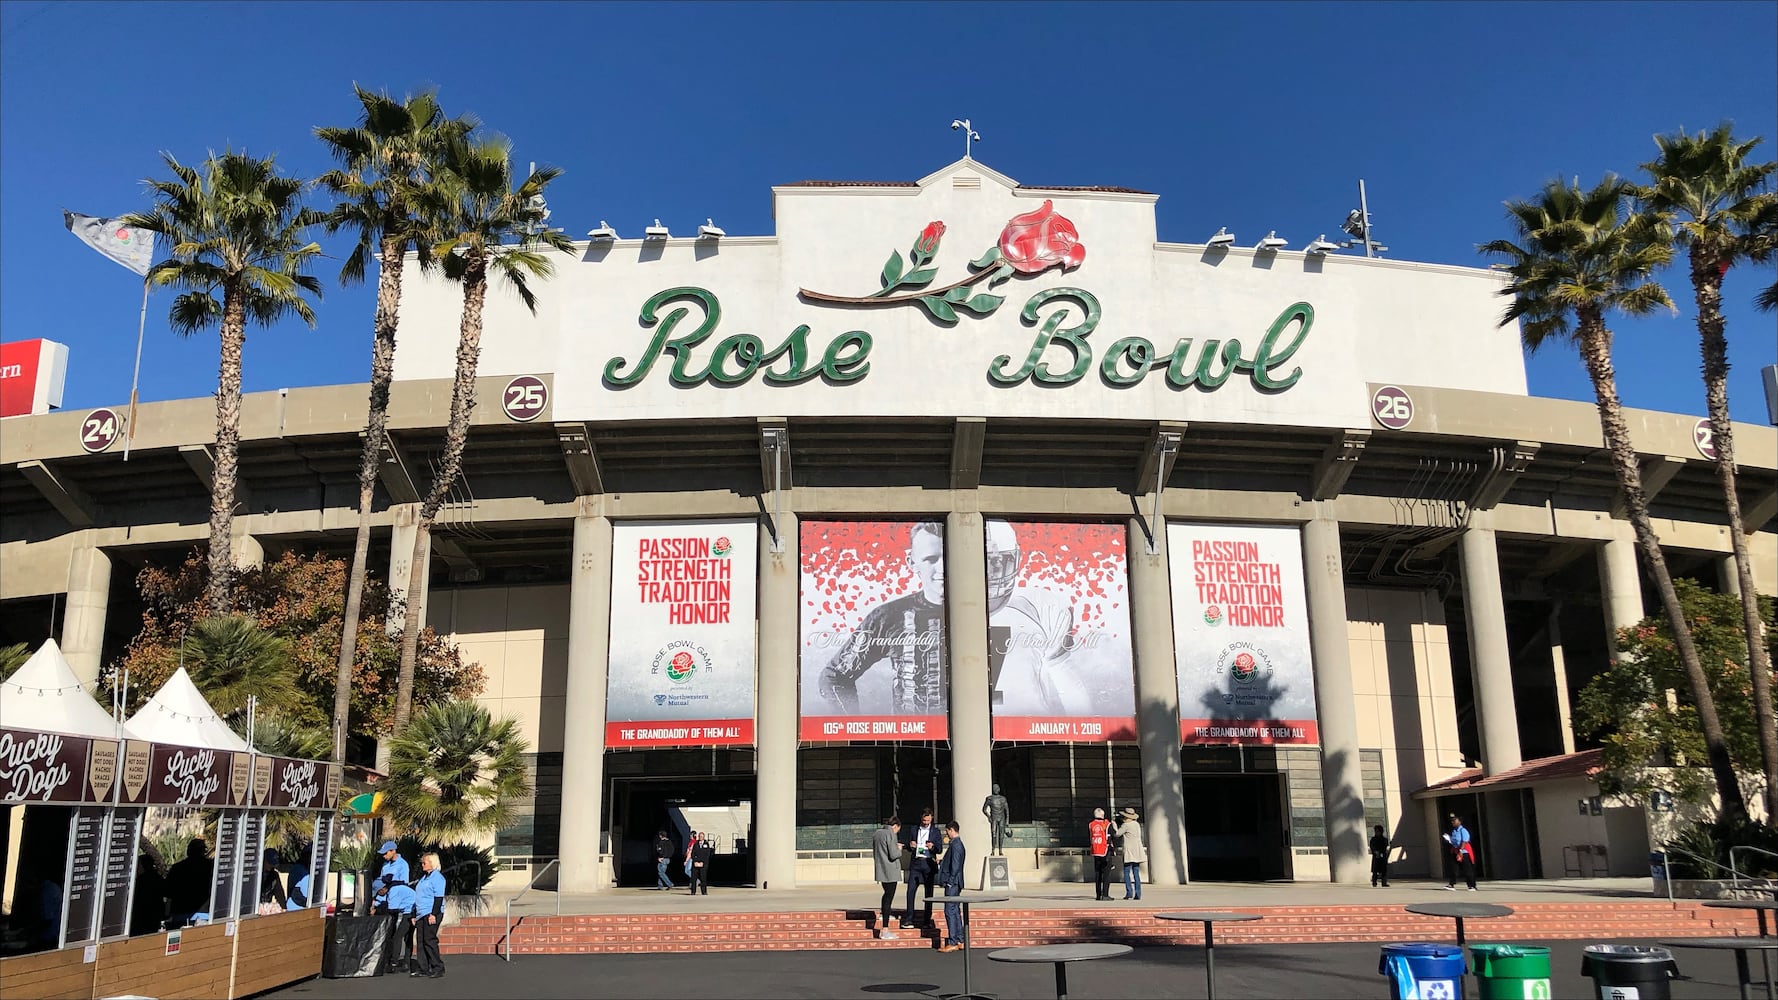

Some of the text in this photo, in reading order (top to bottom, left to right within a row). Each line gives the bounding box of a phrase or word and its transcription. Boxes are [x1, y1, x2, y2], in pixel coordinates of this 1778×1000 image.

[603, 286, 1314, 388] Rose Bowl
[0, 364, 21, 379] rn
[507, 385, 544, 410] 25
[1377, 395, 1410, 419] 26
[83, 417, 115, 442] 24
[1697, 427, 1714, 449] 2
[639, 538, 709, 559] PASSION
[1192, 540, 1259, 562] PASSION
[638, 559, 731, 581] STRENGTH
[1194, 562, 1281, 584] STRENGTH
[638, 580, 731, 603] TRADITION
[1195, 583, 1283, 605] TRADITION
[669, 602, 730, 625] HONOR
[1227, 605, 1285, 627] HONOR
[855, 630, 940, 652] Granddaddy
[651, 639, 713, 675] ROSE BOWL GAME
[1217, 641, 1274, 676] ROSE BOWL GAME
[620, 727, 739, 740] THE GRANDDADDY OF THEM ALL
[823, 722, 926, 734] 105th ROSE BOWL GAME
[1029, 723, 1070, 735] JANUARY
[1081, 723, 1102, 735] 2019
[1194, 727, 1305, 738] THE GRANDDADDY OF THEM ALL
[164, 749, 216, 787] Lucky
[281, 761, 316, 793] Lucky
[5, 762, 71, 801] Dogs
[175, 773, 220, 805] Dogs
[288, 782, 319, 808] Dogs
